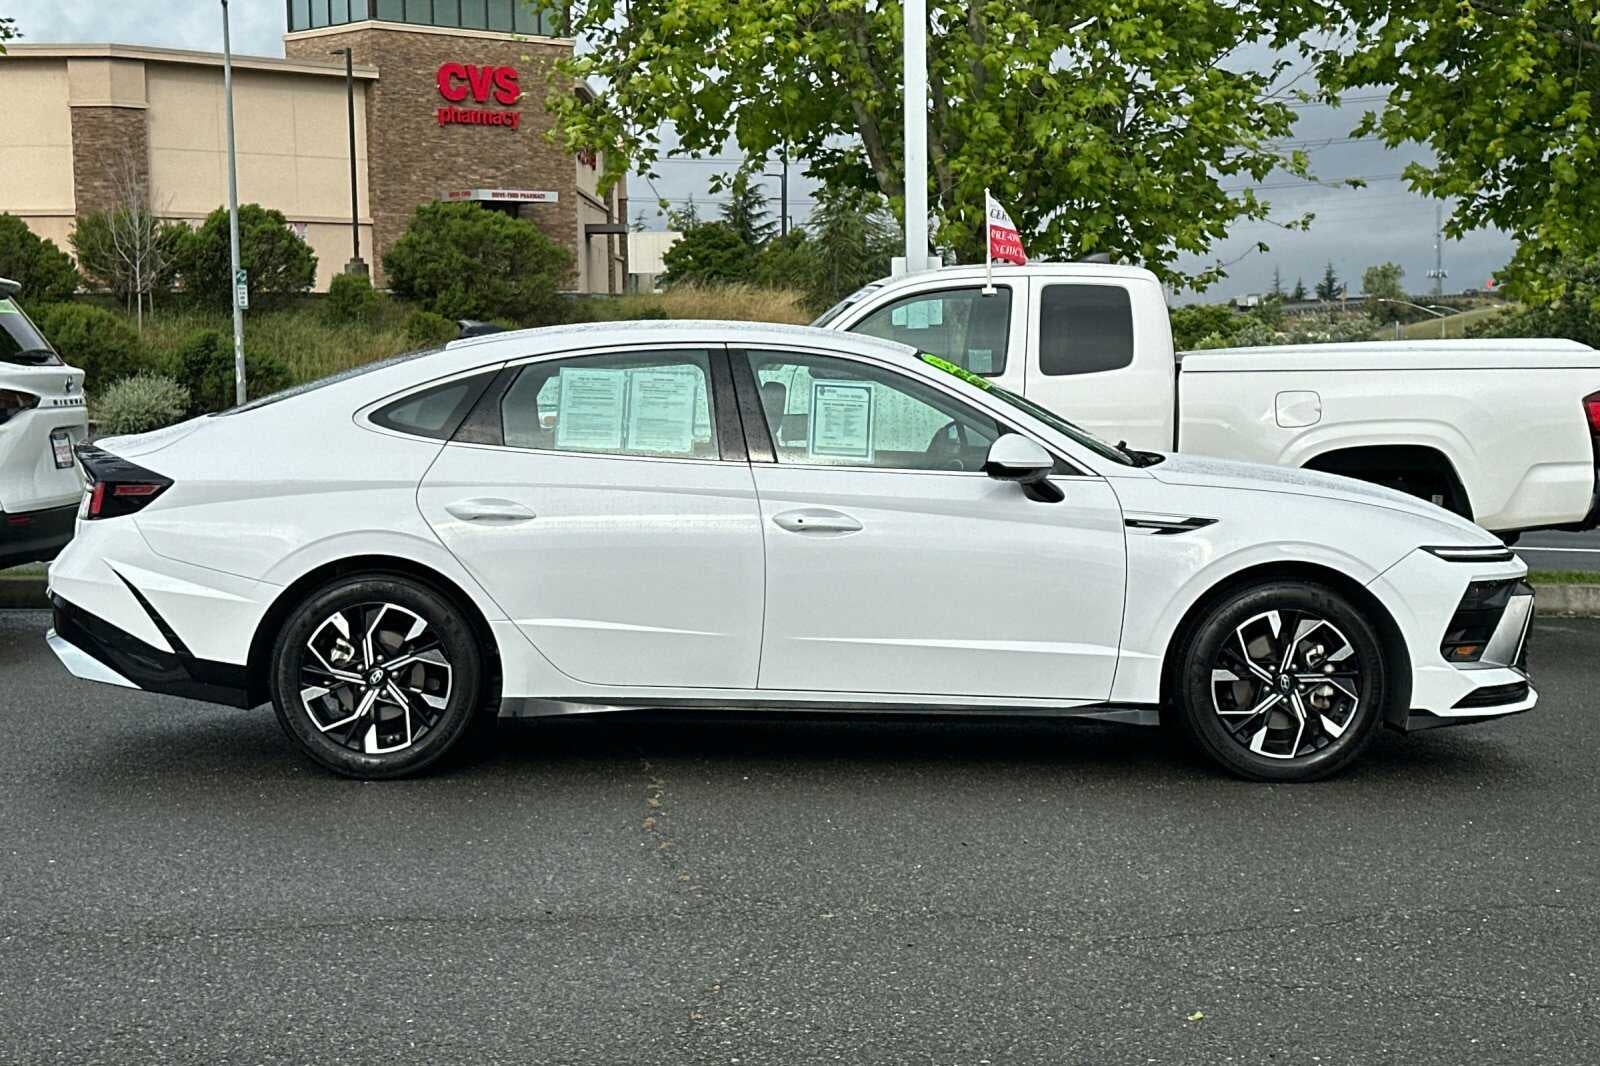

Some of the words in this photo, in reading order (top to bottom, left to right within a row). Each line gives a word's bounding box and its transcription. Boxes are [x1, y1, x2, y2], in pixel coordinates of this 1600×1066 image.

[436, 62, 521, 105] CVS
[437, 106, 521, 130] pharmacy
[520, 192, 546, 200] PHARMACY
